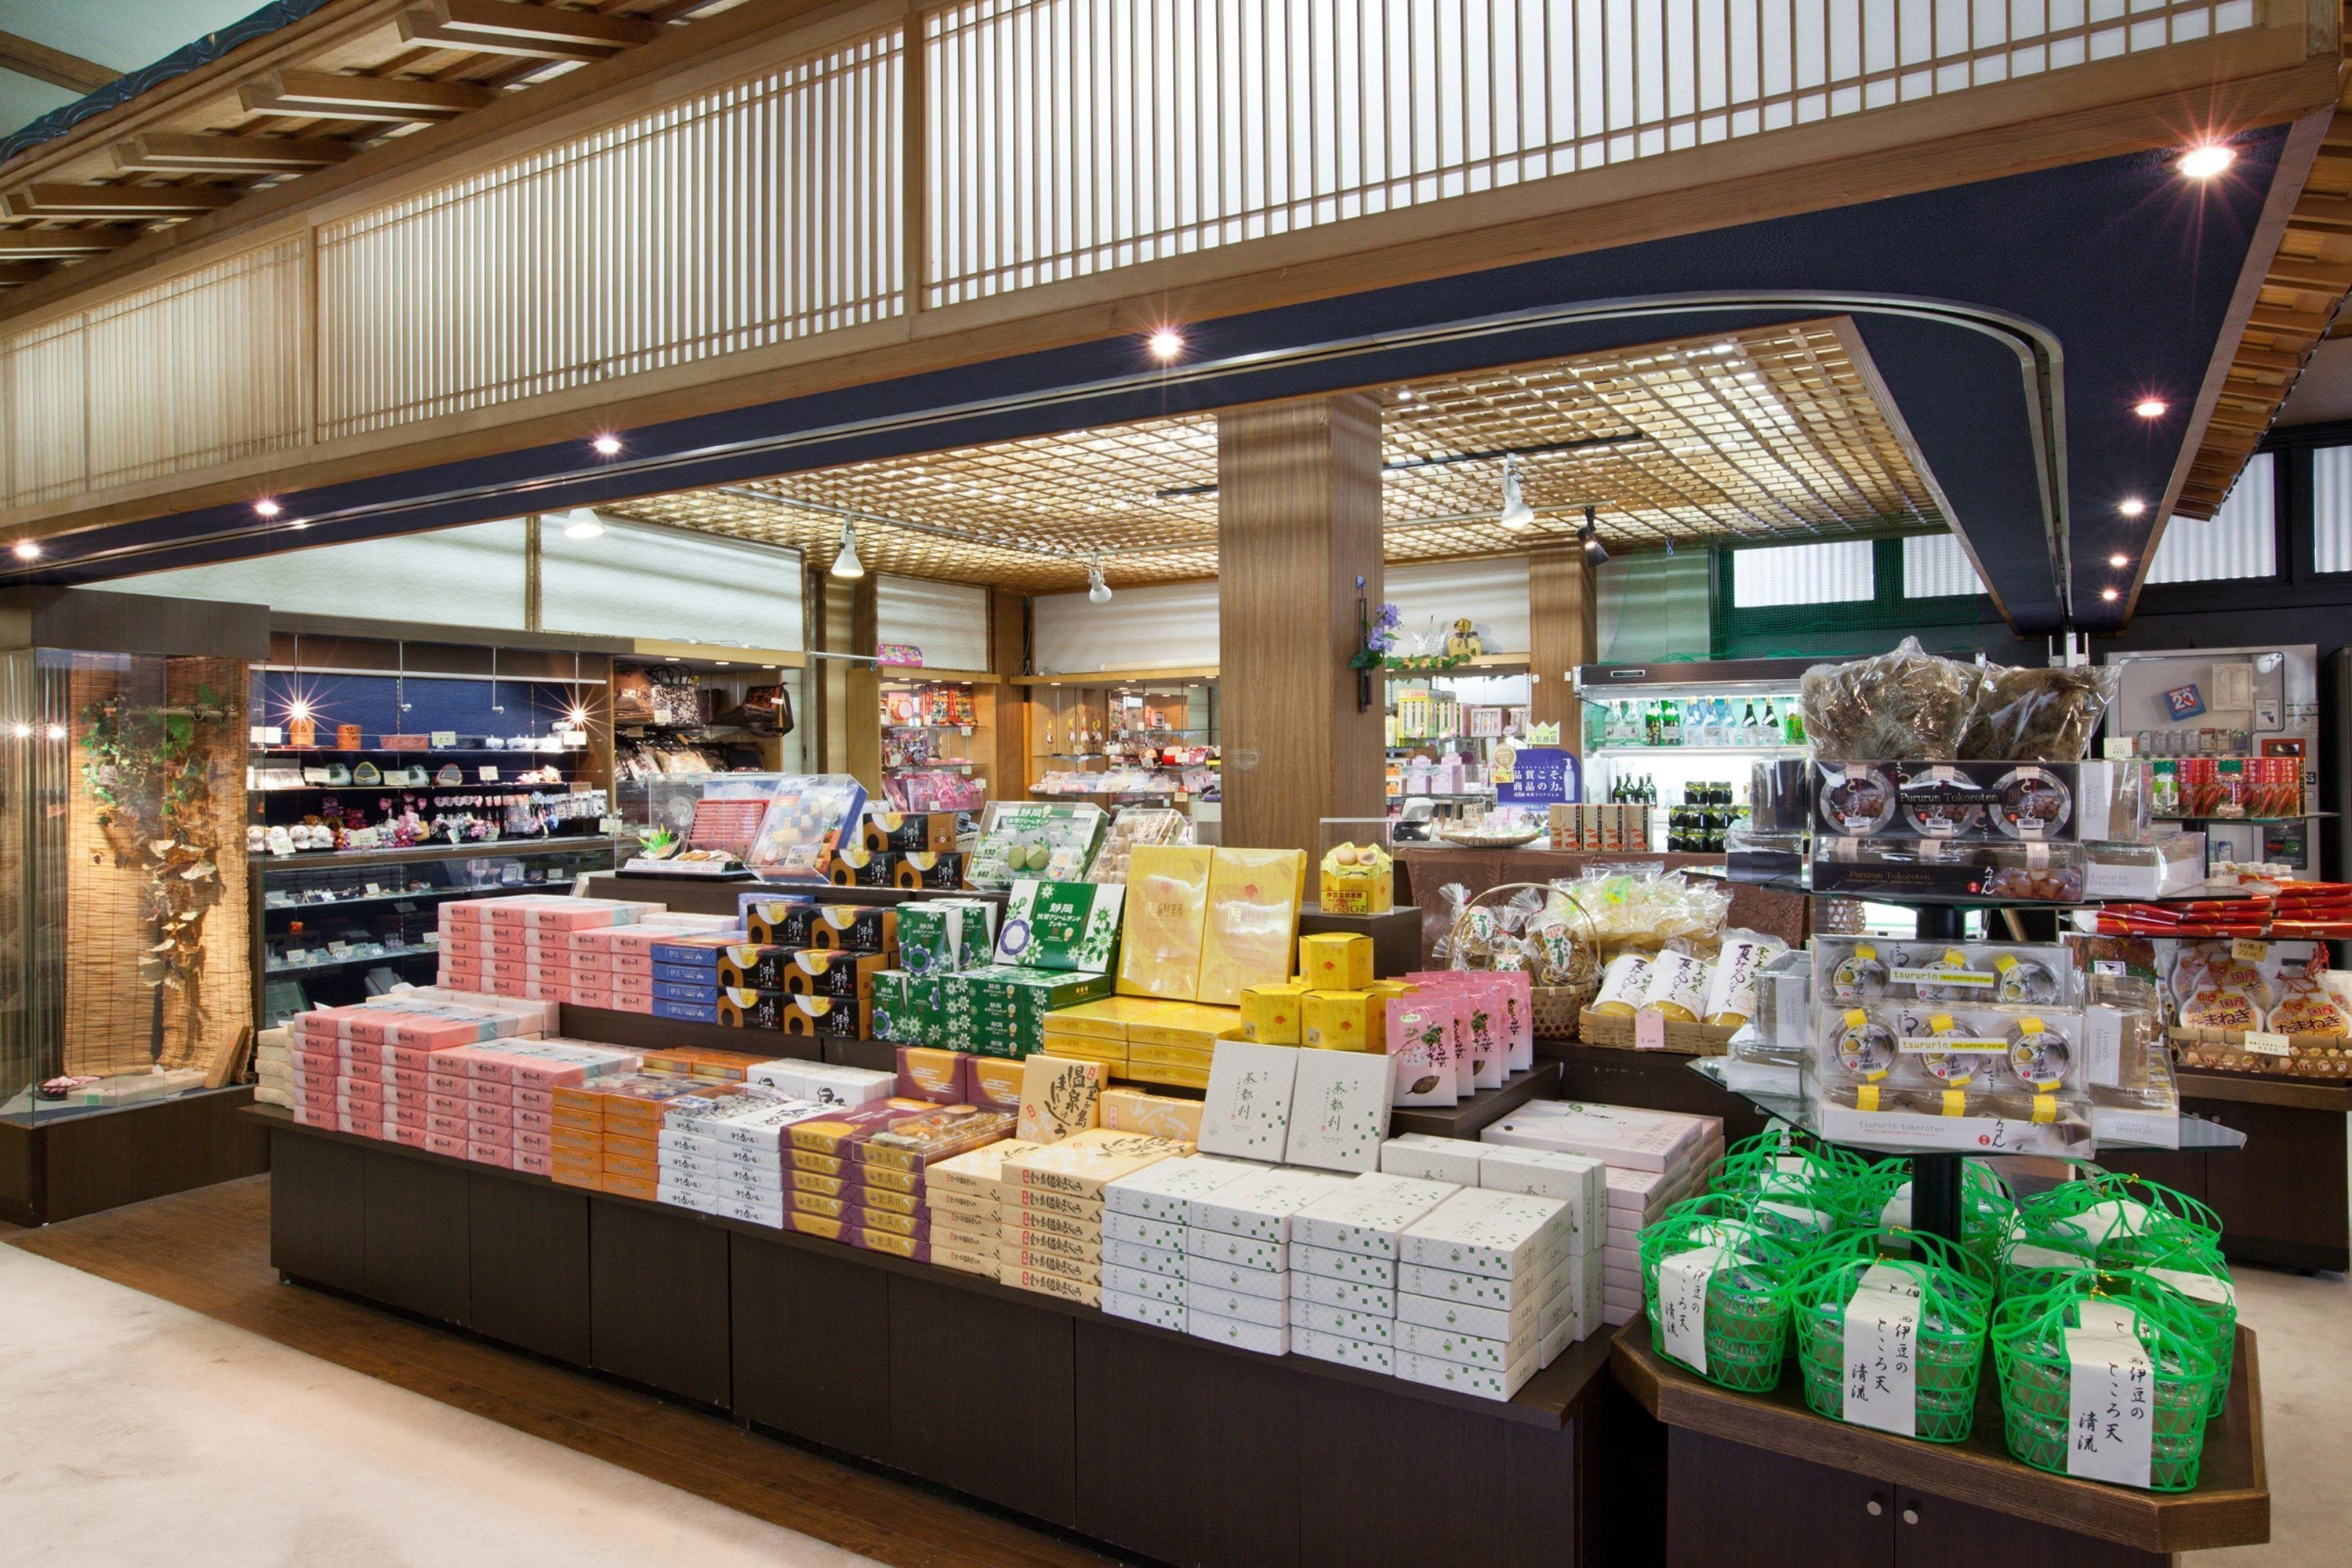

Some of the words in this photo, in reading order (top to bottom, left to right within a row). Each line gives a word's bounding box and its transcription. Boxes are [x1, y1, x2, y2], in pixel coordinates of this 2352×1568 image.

[2172, 692, 2195, 710] 20
[1514, 770, 1563, 779] 品質こそ、
[1514, 782, 1563, 791] 商品の力。
[1900, 793, 1940, 803] Pururun
[1944, 792, 1998, 802] Tokoroten
[1021, 808, 1042, 816] 静岡
[1850, 870, 1883, 879] Pururun
[1886, 872, 1931, 880] Tokoroten
[1049, 903, 1073, 913] 静岡
[1894, 971, 1937, 980] tsururin
[2220, 996, 2247, 1009] 国産
[2307, 1004, 2337, 1015] 国産
[2188, 1007, 2252, 1027] たまねぎ
[2277, 1014, 2341, 1034] たまねぎ
[1903, 1040, 1948, 1050] tsururin
[1065, 1065, 1085, 1113] 温泉
[1044, 1074, 1071, 1138] まんじゅう
[1075, 1079, 1101, 1127] 堂ヶ島
[1860, 1121, 1898, 1131] tsururin
[1901, 1123, 1944, 1133] tokoroten
[1679, 1265, 1690, 1332] ところ天
[1665, 1301, 1679, 1338] 清流
[1875, 1319, 1890, 1393] ところ天
[1851, 1363, 1869, 1402] 清流
[2106, 1361, 2124, 1443] ところ天
[2077, 1410, 2099, 1454] 清流
